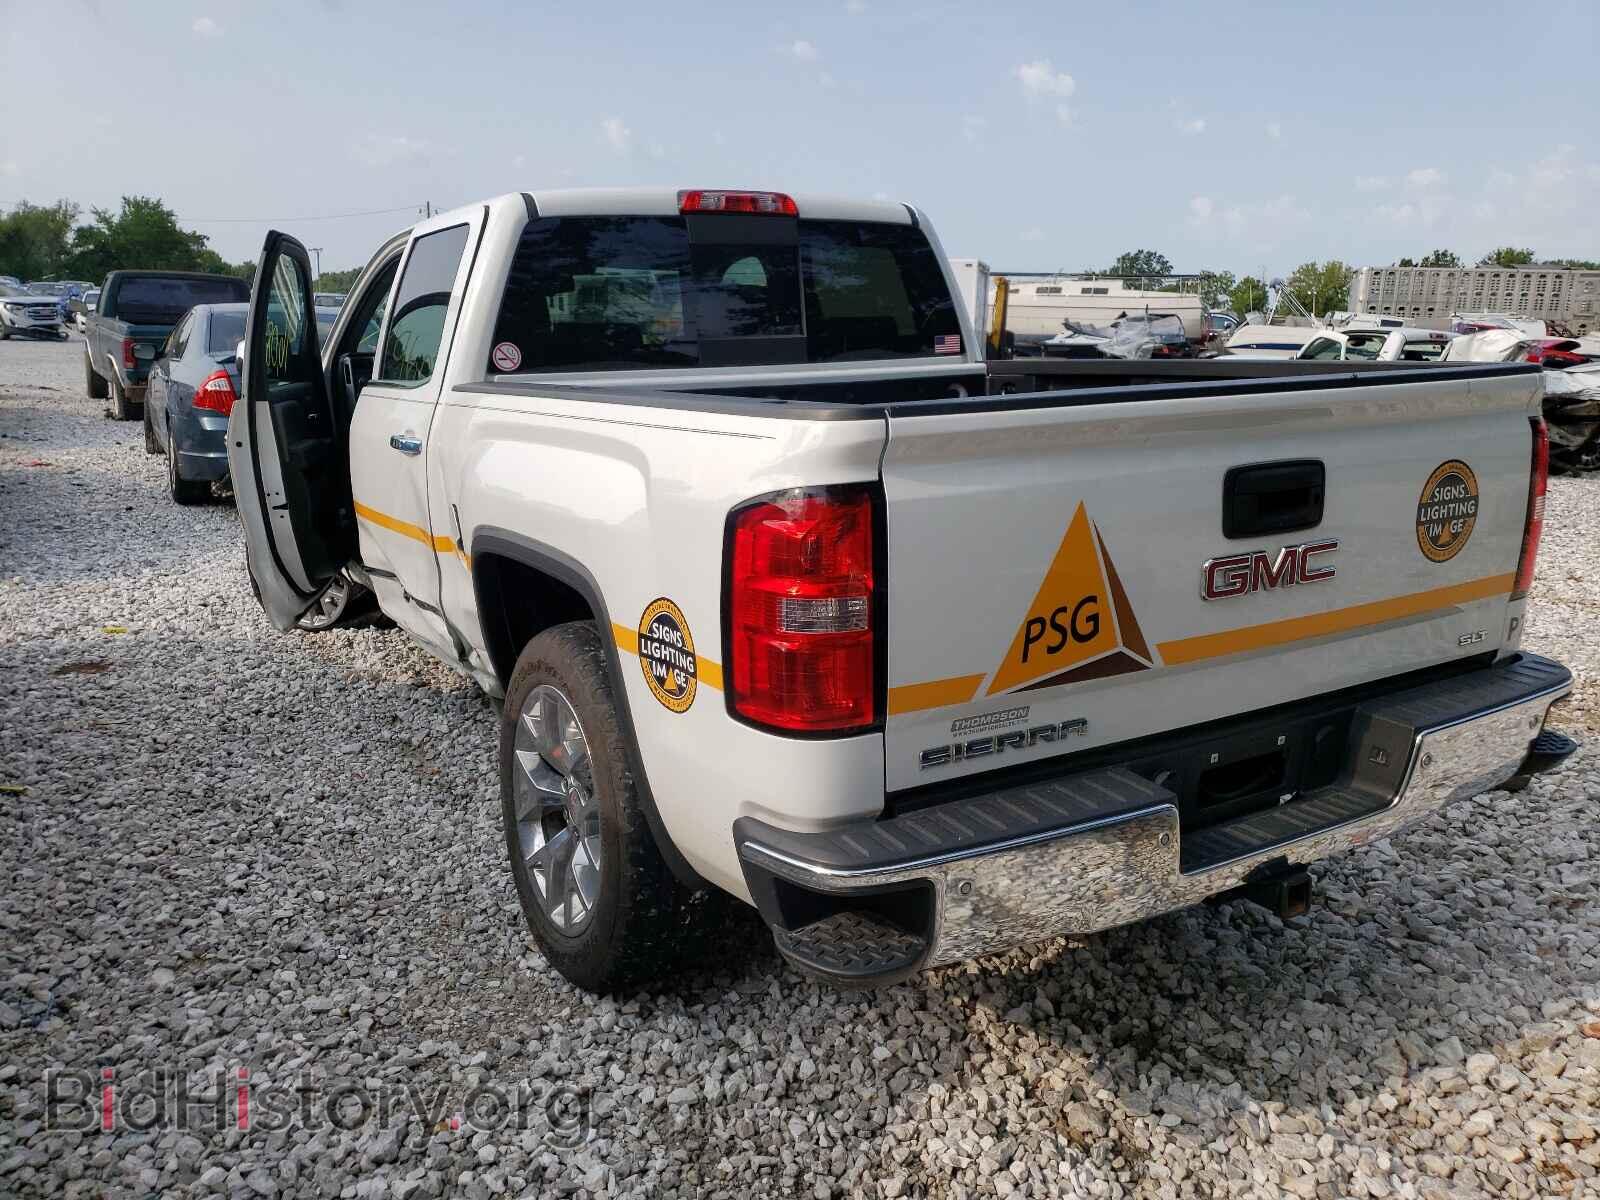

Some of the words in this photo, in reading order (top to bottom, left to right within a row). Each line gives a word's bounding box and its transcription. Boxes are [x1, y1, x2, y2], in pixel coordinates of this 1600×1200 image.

[1434, 484, 1466, 502] SIGNS
[1421, 500, 1476, 521] LIGHTING
[1201, 538, 1338, 600] GMC
[652, 622, 683, 648] SIGNS
[1021, 595, 1100, 663] PSG
[1458, 629, 1489, 647] SLT
[641, 638, 695, 673] LIGHTING
[950, 706, 1031, 733] THOMPSON
[919, 717, 1089, 770] SIERRA
